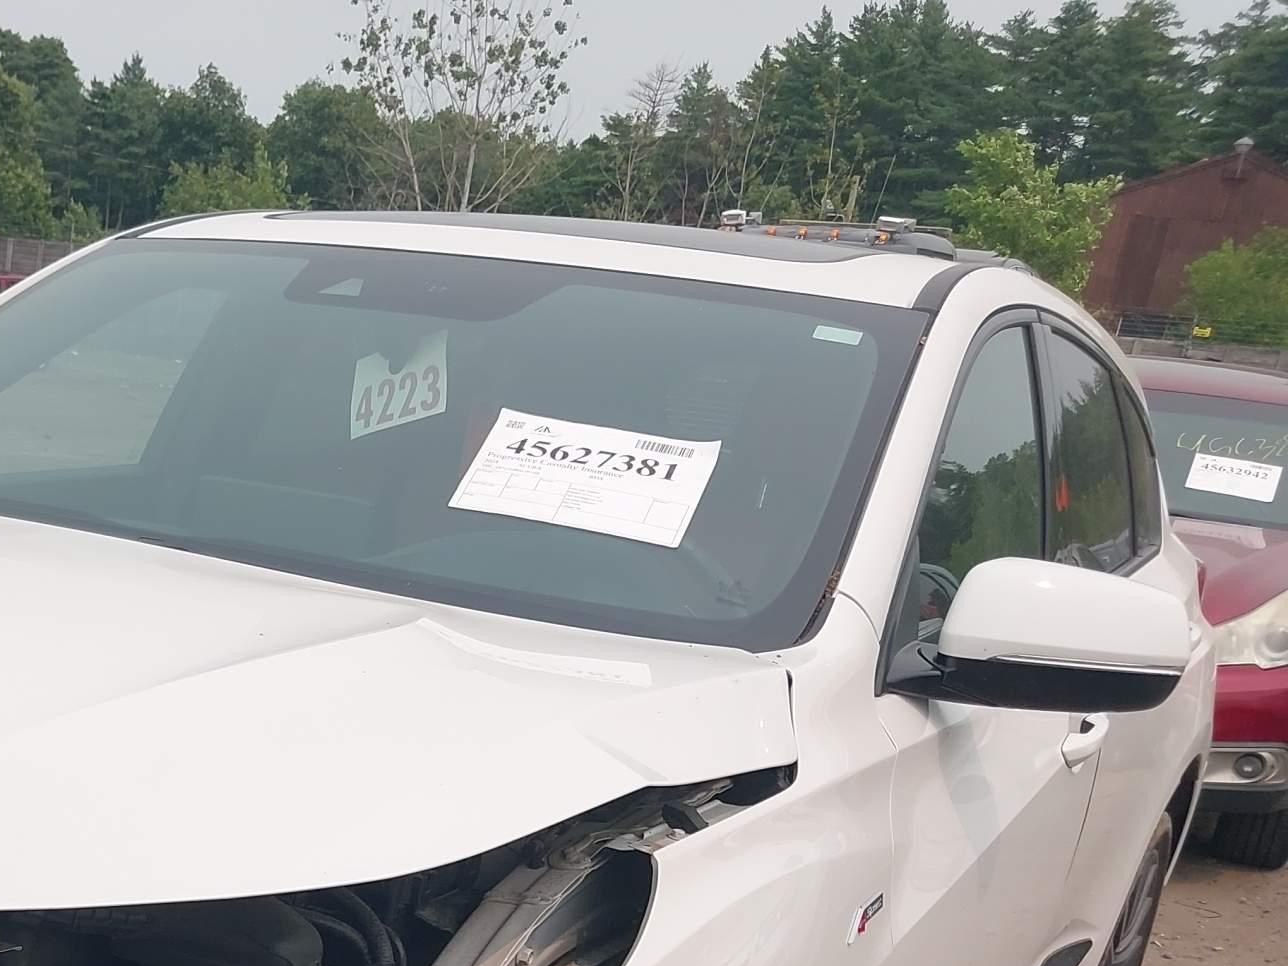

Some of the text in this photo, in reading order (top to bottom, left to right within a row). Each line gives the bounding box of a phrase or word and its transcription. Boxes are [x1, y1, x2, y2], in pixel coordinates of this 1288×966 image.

[355, 365, 441, 429] 4223
[506, 438, 678, 481] 45627381
[580, 466, 625, 479] Insurance
[1200, 462, 1269, 480] 45632942
